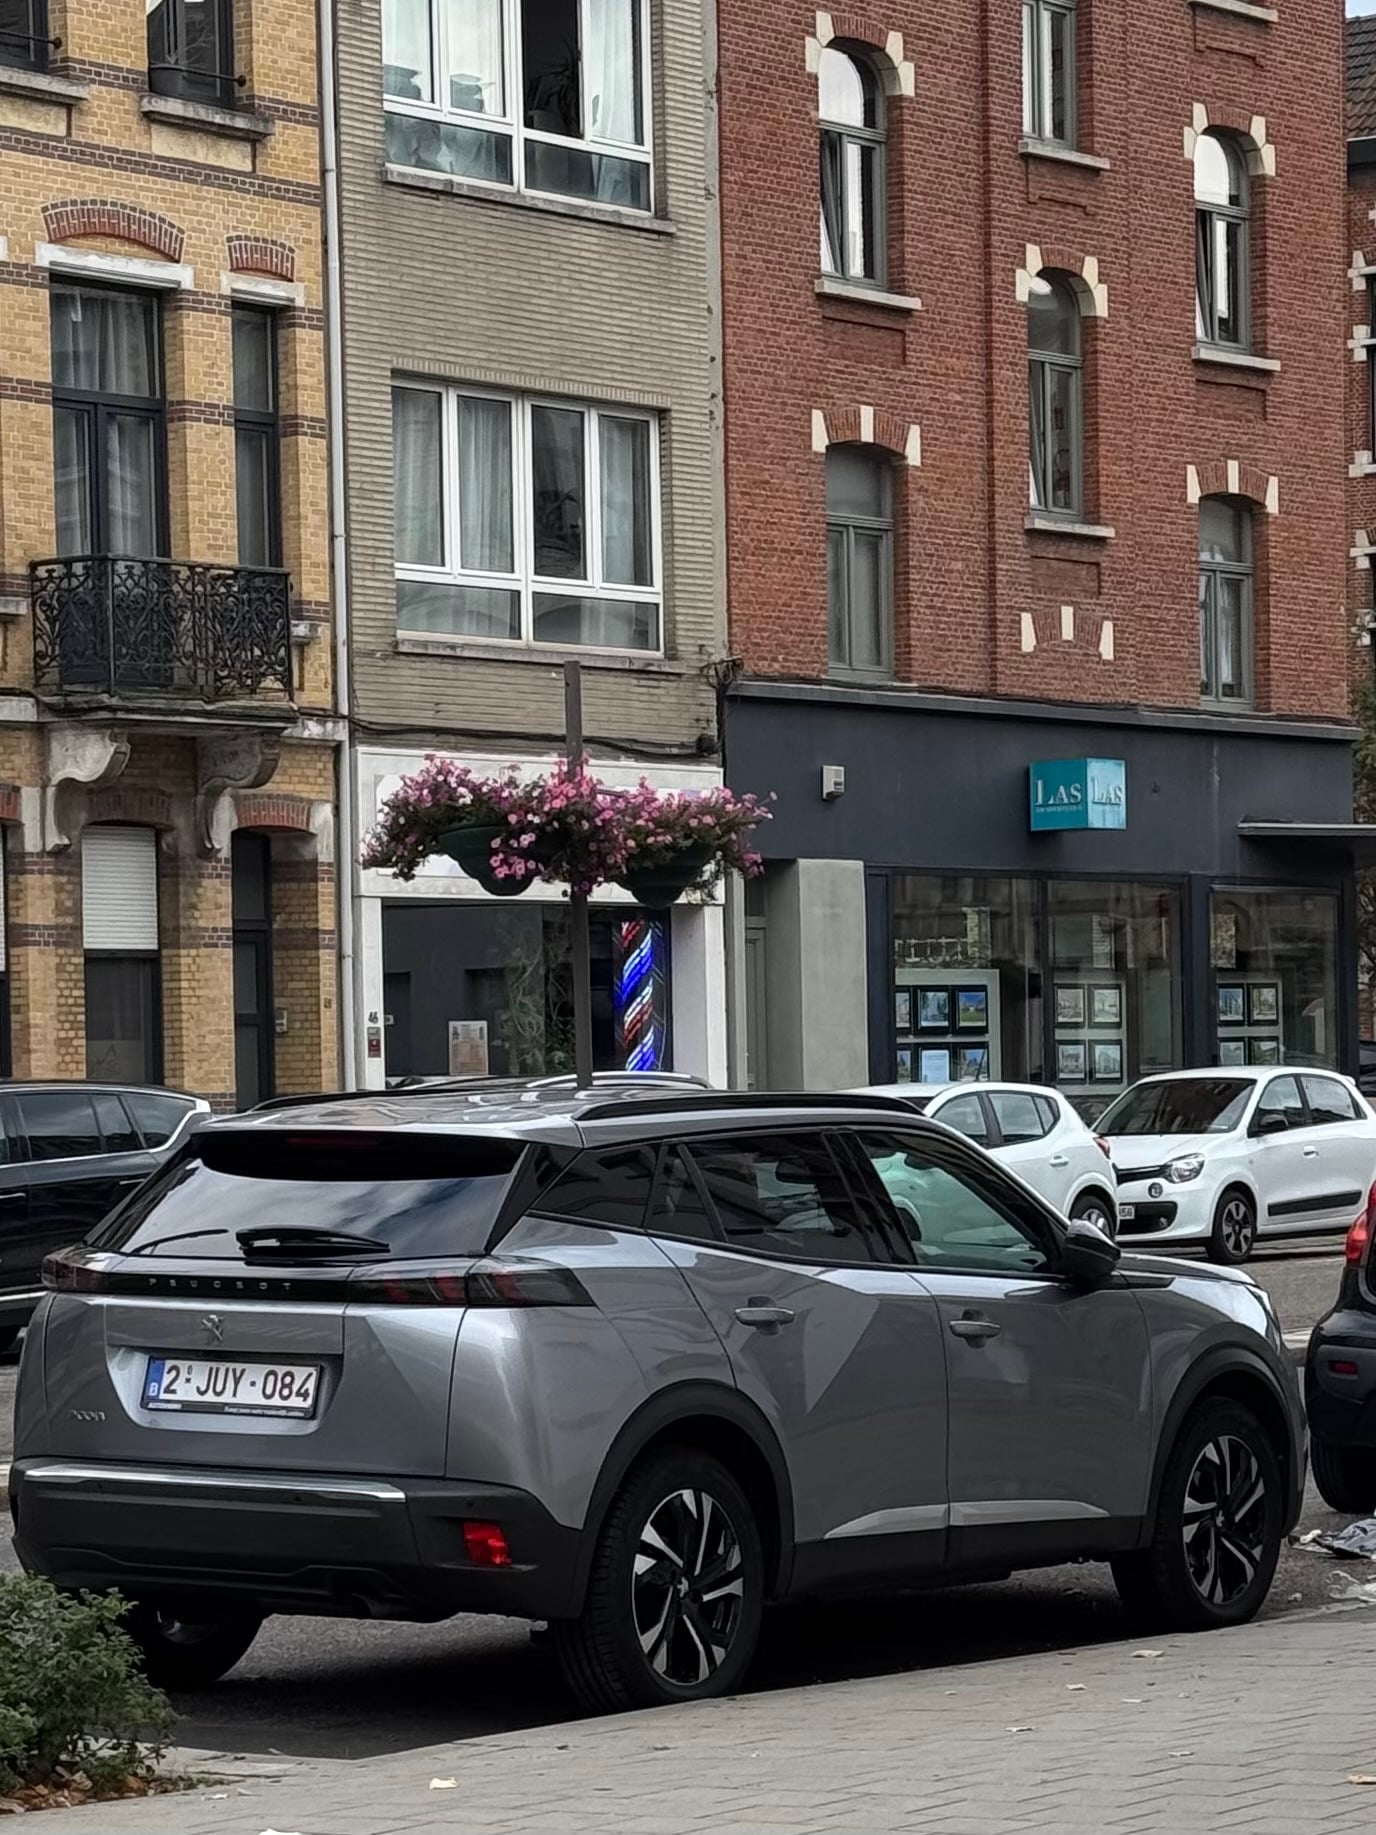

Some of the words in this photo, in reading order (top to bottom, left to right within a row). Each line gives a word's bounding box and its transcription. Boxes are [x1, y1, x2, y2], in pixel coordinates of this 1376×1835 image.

[1034, 778, 1082, 805] LAS
[1091, 777, 1123, 804] LAS
[148, 1277, 292, 1290] PEUGEOT
